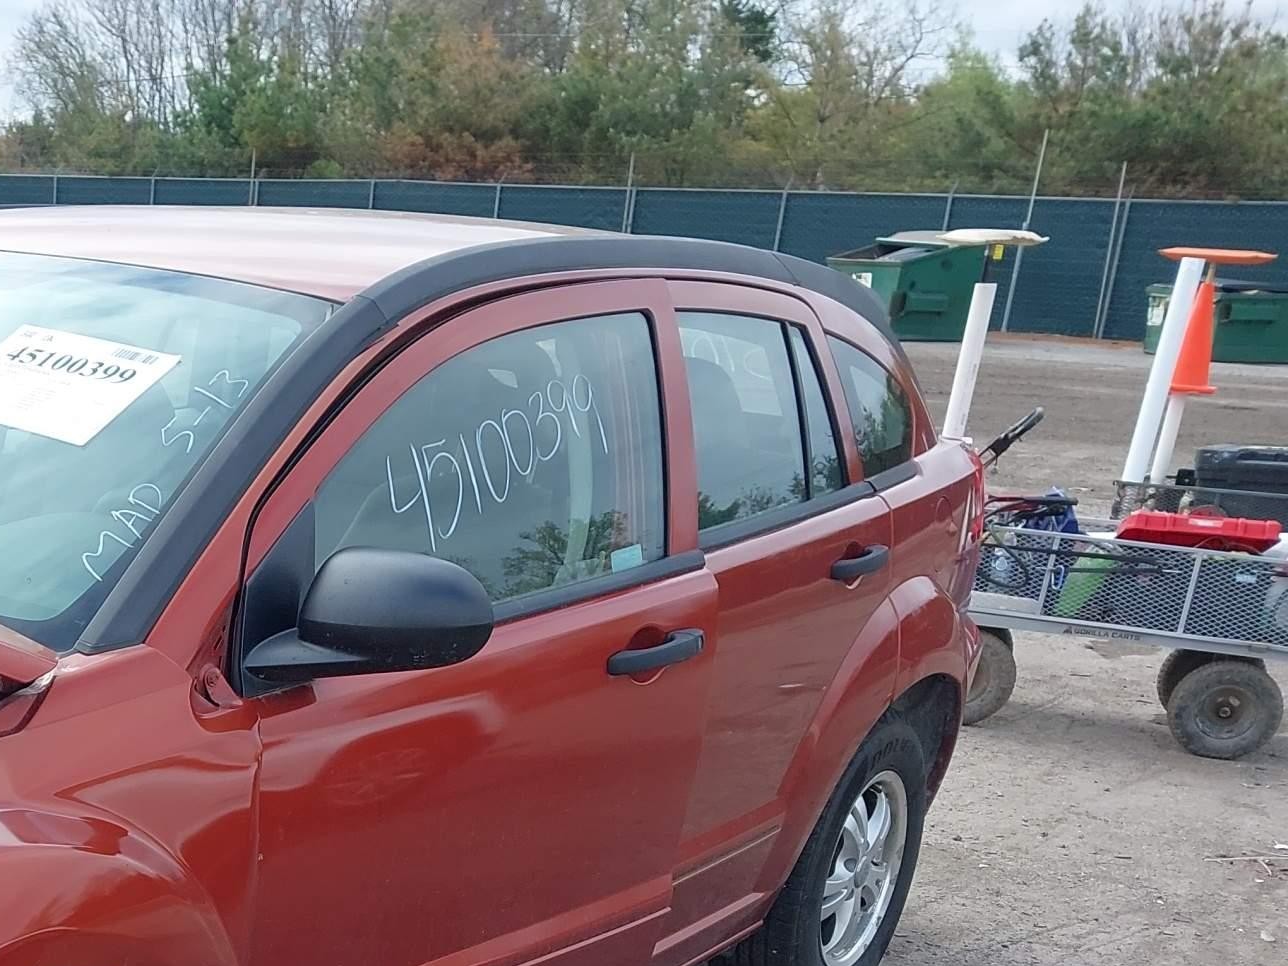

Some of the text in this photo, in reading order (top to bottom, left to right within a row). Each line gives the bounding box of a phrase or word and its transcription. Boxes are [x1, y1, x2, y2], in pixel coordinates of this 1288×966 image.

[6, 346, 137, 384] 45100399
[81, 369, 249, 582] MAD 5-13
[386, 374, 609, 553] 45100399
